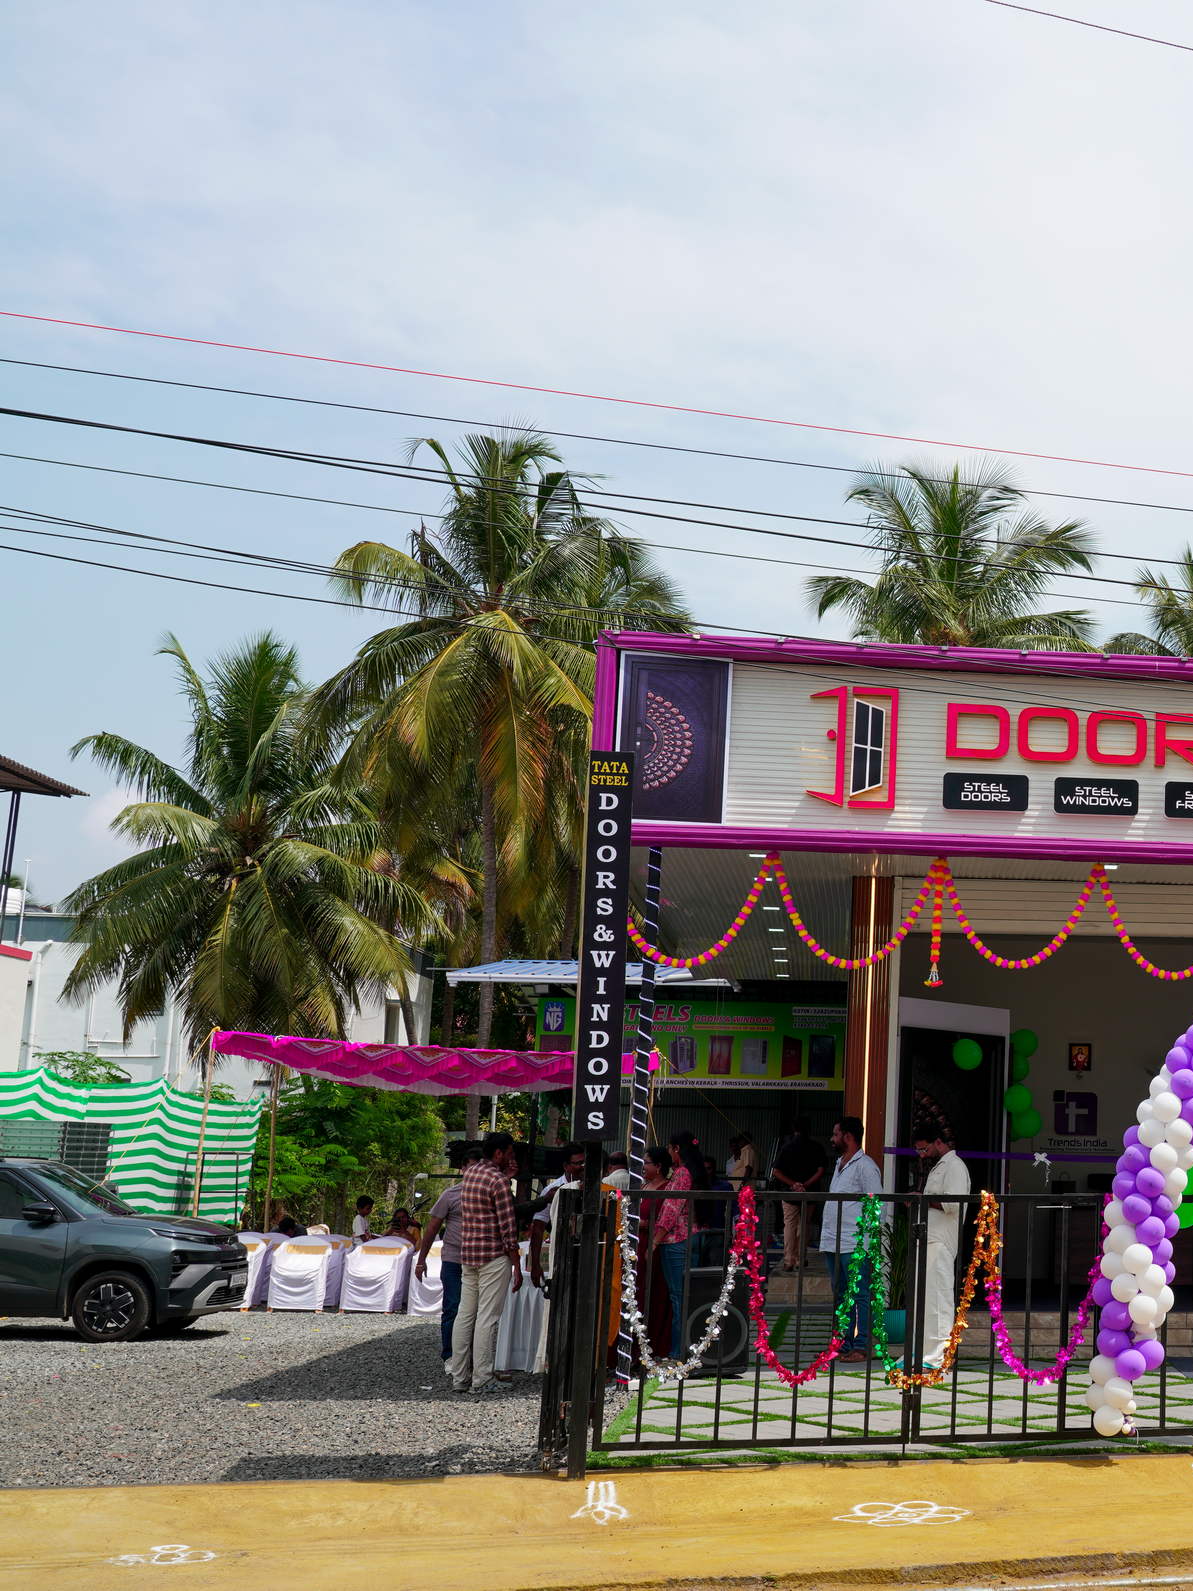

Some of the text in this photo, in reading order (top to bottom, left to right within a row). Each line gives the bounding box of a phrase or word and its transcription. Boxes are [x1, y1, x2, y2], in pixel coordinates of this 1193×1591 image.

[592, 760, 629, 774] TATA
[591, 774, 629, 787] STEEL
[963, 781, 1007, 793] STEEL
[960, 791, 1011, 803] DOORS
[1074, 786, 1118, 798] STEEL
[1060, 795, 1132, 808] WINDOWS
[594, 793, 620, 916] DOORS
[584, 950, 616, 1130] WINDOWS
[1048, 1137, 1108, 1147] Trends India
